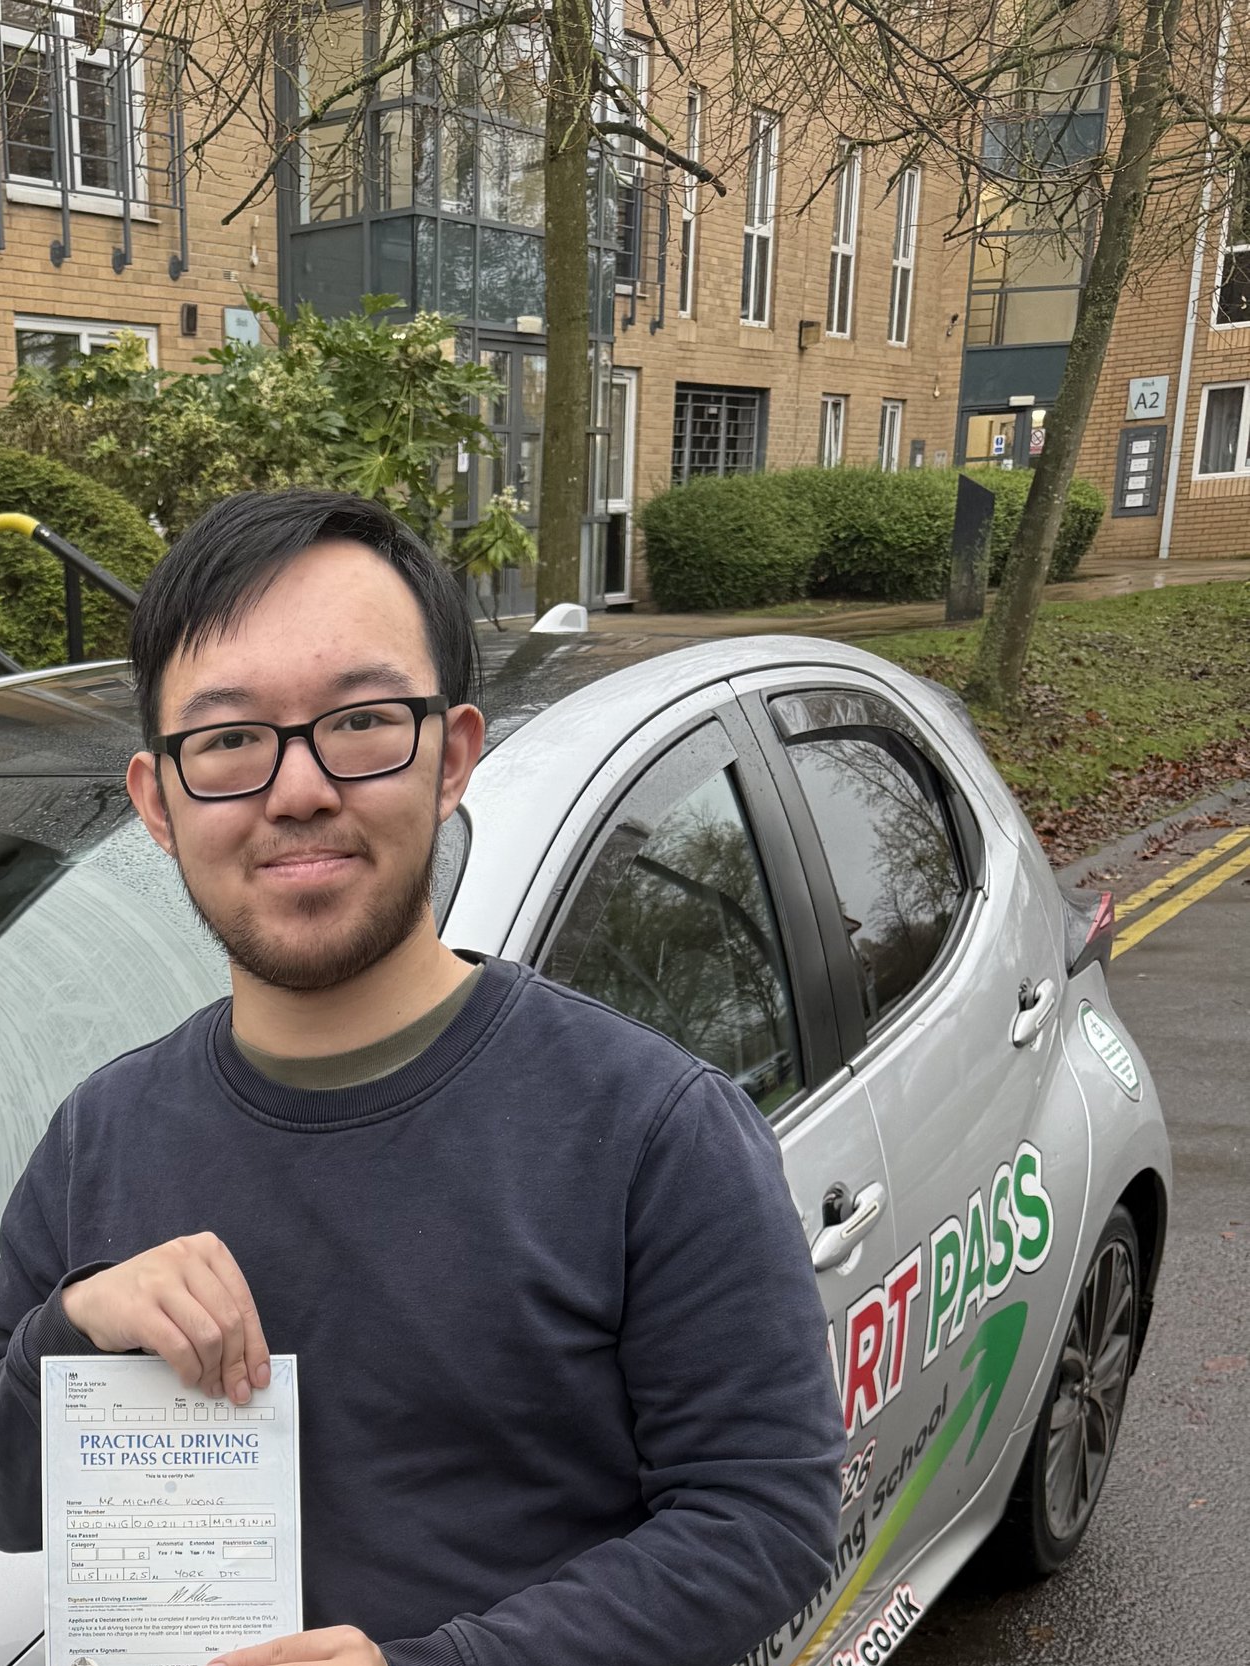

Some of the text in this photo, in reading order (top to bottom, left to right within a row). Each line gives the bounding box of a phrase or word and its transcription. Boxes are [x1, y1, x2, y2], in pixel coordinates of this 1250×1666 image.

[1134, 391, 1160, 410] A2
[923, 1146, 1052, 1364] PASS
[80, 1433, 259, 1449] PRACTICAL DRIVING
[81, 1451, 259, 1465] TEST PASS CERTIFICATE
[872, 1382, 948, 1521] School
[123, 1498, 171, 1506] MICHAEL
